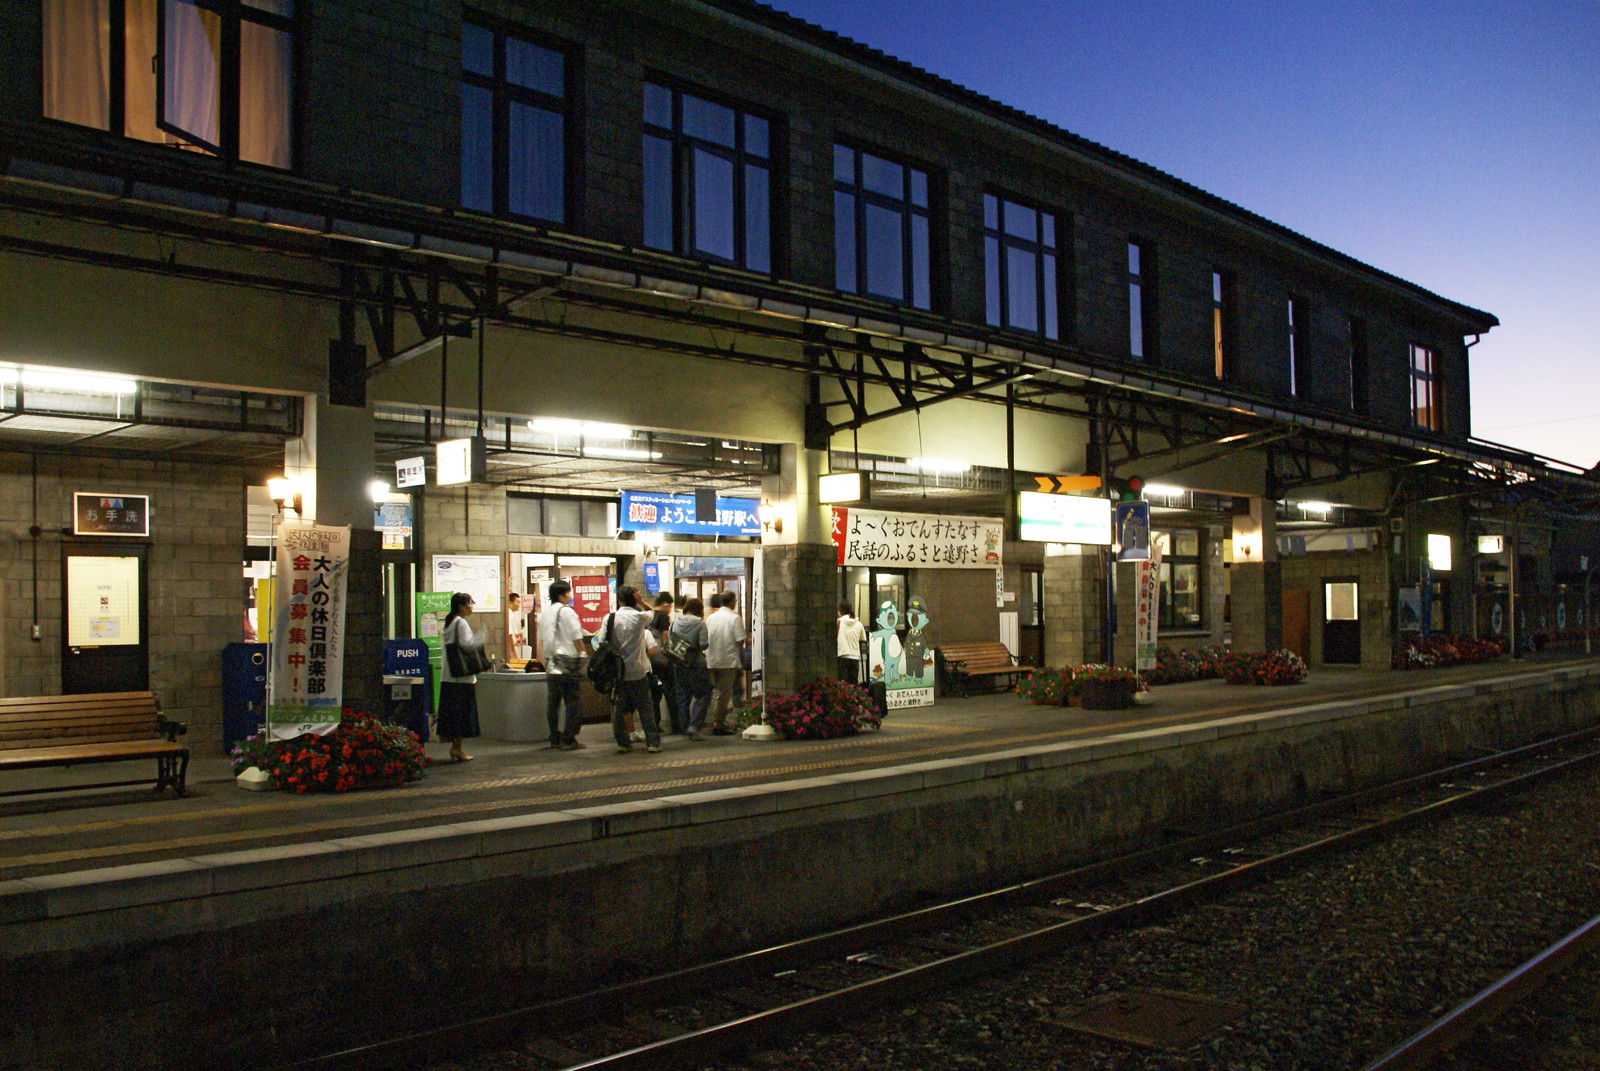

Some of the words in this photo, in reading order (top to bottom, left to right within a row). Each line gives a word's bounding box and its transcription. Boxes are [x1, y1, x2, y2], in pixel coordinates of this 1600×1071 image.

[85, 509, 138, 522] お手洗
[629, 503, 657, 523] 歓迎
[848, 540, 978, 565] 民話のふるさと遠野さ
[308, 555, 331, 694] 大人の休日倶楽部
[396, 649, 419, 658] PUSH
